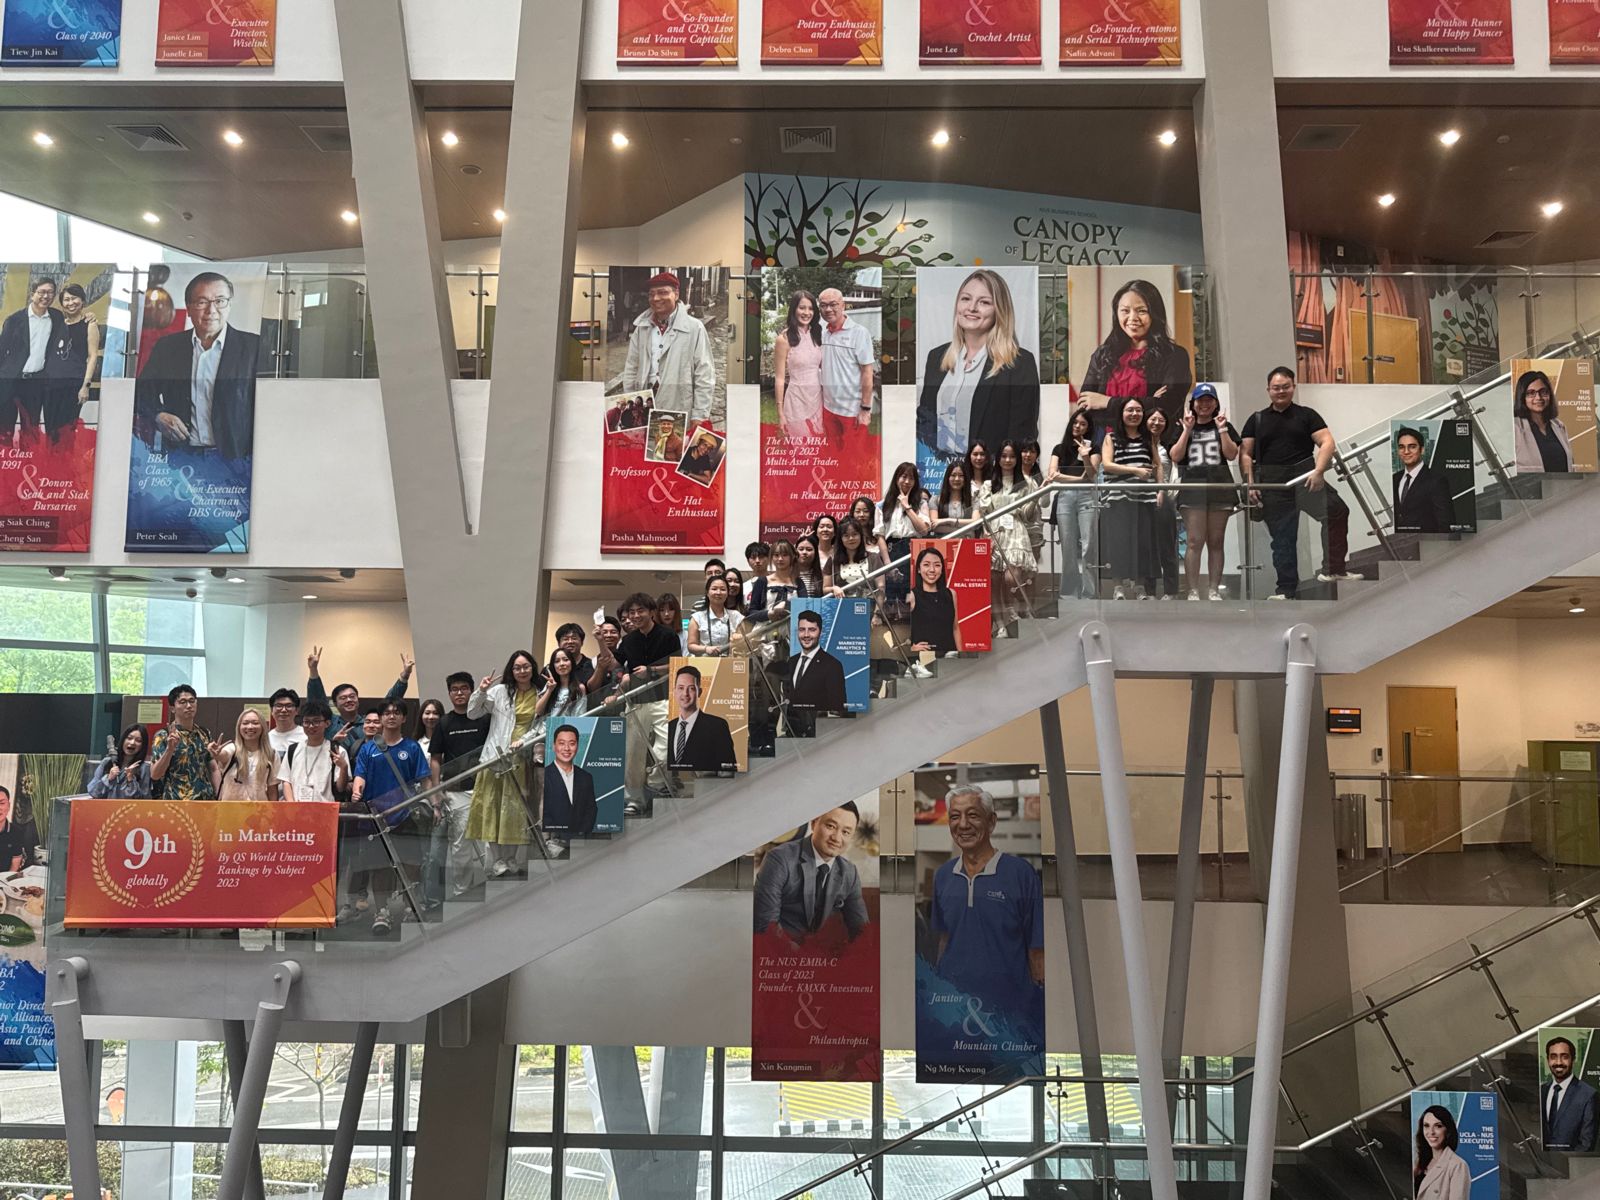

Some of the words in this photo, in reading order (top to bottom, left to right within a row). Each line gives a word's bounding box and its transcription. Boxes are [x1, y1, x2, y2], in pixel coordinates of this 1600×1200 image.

[230, 18, 269, 27] Executive
[683, 13, 734, 23] Co-Founder
[1426, 18, 1468, 27] Marathon
[1471, 18, 1502, 27] Runner
[667, 24, 685, 33] and
[797, 19, 827, 31] Pottery
[829, 19, 876, 29] Enthusiast
[1090, 24, 1142, 34] Co-Founder,
[55, 31, 77, 40] Class
[80, 31, 90, 42] of
[90, 31, 112, 40] 2040
[164, 34, 184, 42] Janice
[230, 28, 268, 38] Directors,
[811, 30, 828, 39] and
[830, 30, 852, 39] Avid
[854, 30, 876, 39] Cook
[968, 32, 1002, 42] Crochet
[1004, 32, 1031, 42] Artist
[1423, 28, 1440, 38] and
[1442, 29, 1471, 40] Happy
[1472, 28, 1503, 37] Dancer
[233, 39, 268, 48] Wiselink
[633, 34, 651, 44] and
[654, 35, 686, 44] Venture
[690, 34, 733, 46] Capitalist
[1065, 35, 1082, 44] and
[1086, 35, 1112, 44] Serial
[10, 48, 29, 56] Tiew
[30, 48, 42, 57] Jin
[45, 48, 58, 56] Kai
[163, 50, 186, 58] Janelle
[624, 49, 646, 57] Bruno
[647, 49, 659, 57] Da
[661, 49, 678, 57] Silva
[769, 46, 791, 54] Debra
[794, 46, 813, 54] Chan
[1013, 216, 1123, 246] CANOPY
[1004, 245, 1018, 255] OF
[1021, 241, 1130, 265] LEGACY
[766, 437, 780, 446] The
[783, 437, 803, 446] NUS
[805, 437, 829, 446] MBA,
[8, 448, 34, 458] Class
[766, 447, 787, 456] Class
[789, 447, 798, 457] of
[800, 447, 819, 456] 2023
[1188, 441, 1221, 466] 99
[147, 453, 168, 464] BBA
[765, 457, 809, 466] Multi-Asset
[813, 457, 839, 467] Trader,
[925, 456, 941, 466] The
[1, 461, 22, 470] 1991
[145, 465, 171, 475] Class
[610, 466, 651, 479] Professor
[765, 467, 798, 476] Amundi
[16, 464, 49, 501] &
[39, 477, 73, 488] Donors
[139, 477, 150, 489] of
[151, 478, 172, 487] 1965
[648, 467, 682, 503] &
[822, 480, 838, 490] The
[840, 481, 860, 490] NUS
[862, 481, 877, 490] BSc
[186, 484, 247, 494] Non-Executive
[46, 490, 66, 499] and
[68, 489, 90, 500] Siak
[790, 491, 798, 500] in
[801, 491, 820, 500] Real
[822, 491, 847, 500] Estate
[191, 495, 239, 506] Chairman
[683, 495, 702, 505] Hat
[33, 501, 77, 511] Bursaries
[825, 501, 846, 510] Class
[188, 508, 210, 518] DBS
[213, 508, 242, 519] Group
[667, 507, 718, 517] Enthusiast
[7, 518, 24, 527] Siak
[26, 518, 50, 529] Ching
[764, 525, 789, 534] Janelle
[26, 535, 41, 543] San
[136, 532, 156, 541] Peter
[159, 532, 178, 541] Seah
[611, 534, 634, 542] Pasha
[637, 534, 677, 542] Mahmood
[219, 829, 233, 842] in
[238, 829, 315, 846] Marketing
[124, 828, 177, 870] 9th
[218, 852, 230, 864] By
[232, 852, 247, 864] QS
[250, 852, 276, 862] World
[280, 852, 324, 864] University
[217, 865, 259, 877] Rankings
[262, 865, 272, 877] by
[274, 865, 305, 877] Subject
[126, 874, 168, 889] globally
[216, 878, 240, 888] 2023
[760, 957, 773, 966] The
[777, 957, 797, 967] NUS
[800, 957, 838, 967] EMBA-C
[759, 970, 780, 979] Class
[783, 970, 793, 982] of
[793, 970, 814, 979] 2023
[759, 983, 794, 993] Founder,
[796, 983, 827, 993] KMXK
[829, 984, 873, 993] Investment
[928, 993, 963, 1005] Janitor
[793, 992, 827, 1029] &
[962, 996, 999, 1037] &
[21, 1024, 54, 1037] Pacific,
[4, 1035, 23, 1045] and
[26, 1035, 54, 1046] China
[809, 1035, 869, 1047] Philanthropist
[953, 1040, 998, 1051] Mountain
[1001, 1041, 1037, 1051] Climber
[760, 1063, 774, 1071] Xin
[776, 1063, 812, 1072] Kangmin
[925, 1064, 937, 1074] Ng
[938, 1064, 956, 1074] Moy
[958, 1065, 986, 1074] Kwang
